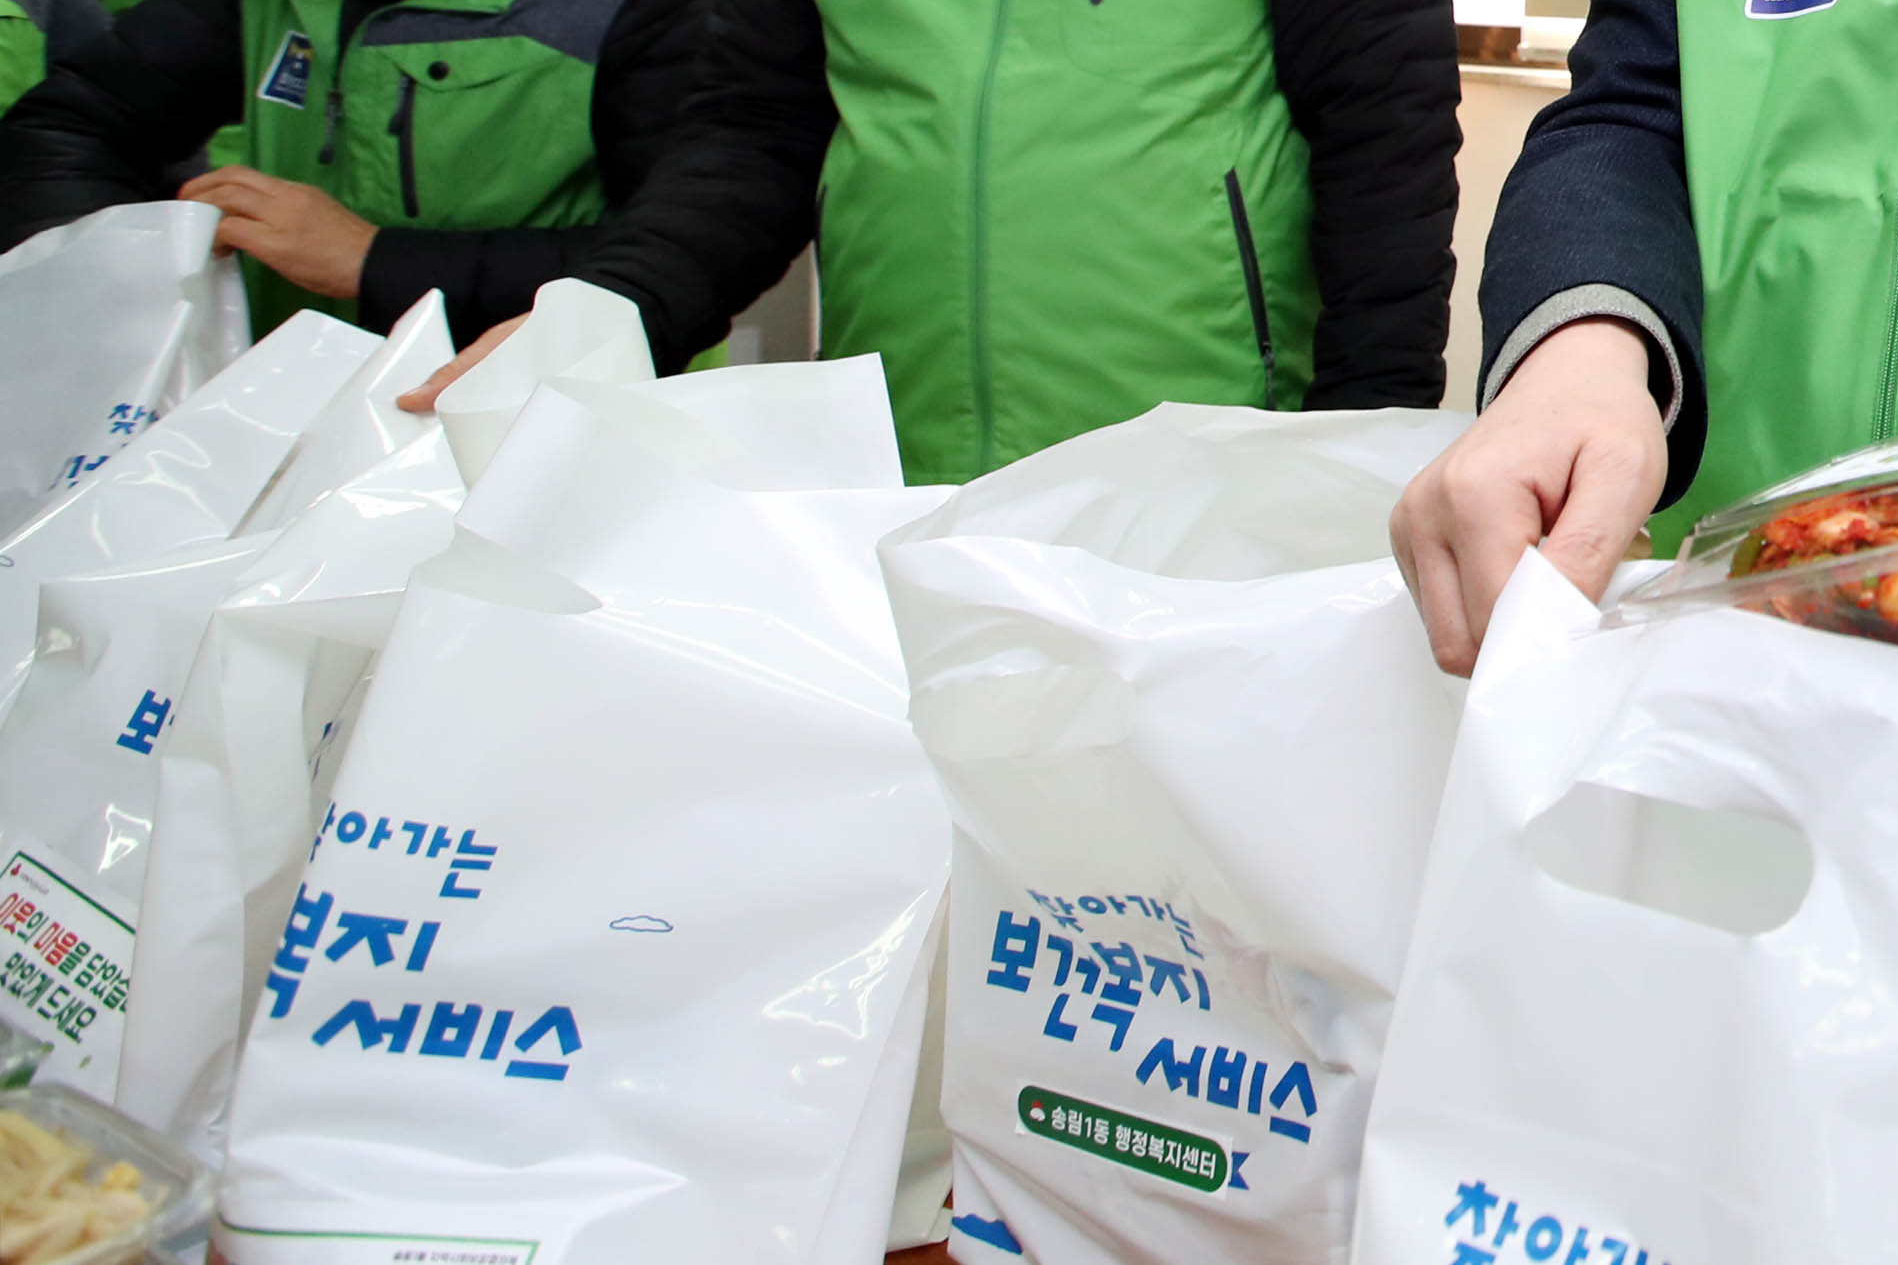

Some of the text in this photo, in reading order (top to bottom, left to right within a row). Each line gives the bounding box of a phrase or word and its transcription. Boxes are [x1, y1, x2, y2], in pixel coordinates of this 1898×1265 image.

[1025, 888, 1205, 961] 찾아가는
[33, 921, 92, 976] 마음을
[73, 952, 131, 1013] 담았습
[986, 909, 1212, 1053] 보건복지
[36, 984, 98, 1045] 드세요
[310, 998, 583, 1082] 서비스
[1135, 1037, 1318, 1144] 서비스
[1051, 1104, 1217, 1180] 송림1동 행정복지센터
[1444, 1180, 1672, 1265] 찾아가
